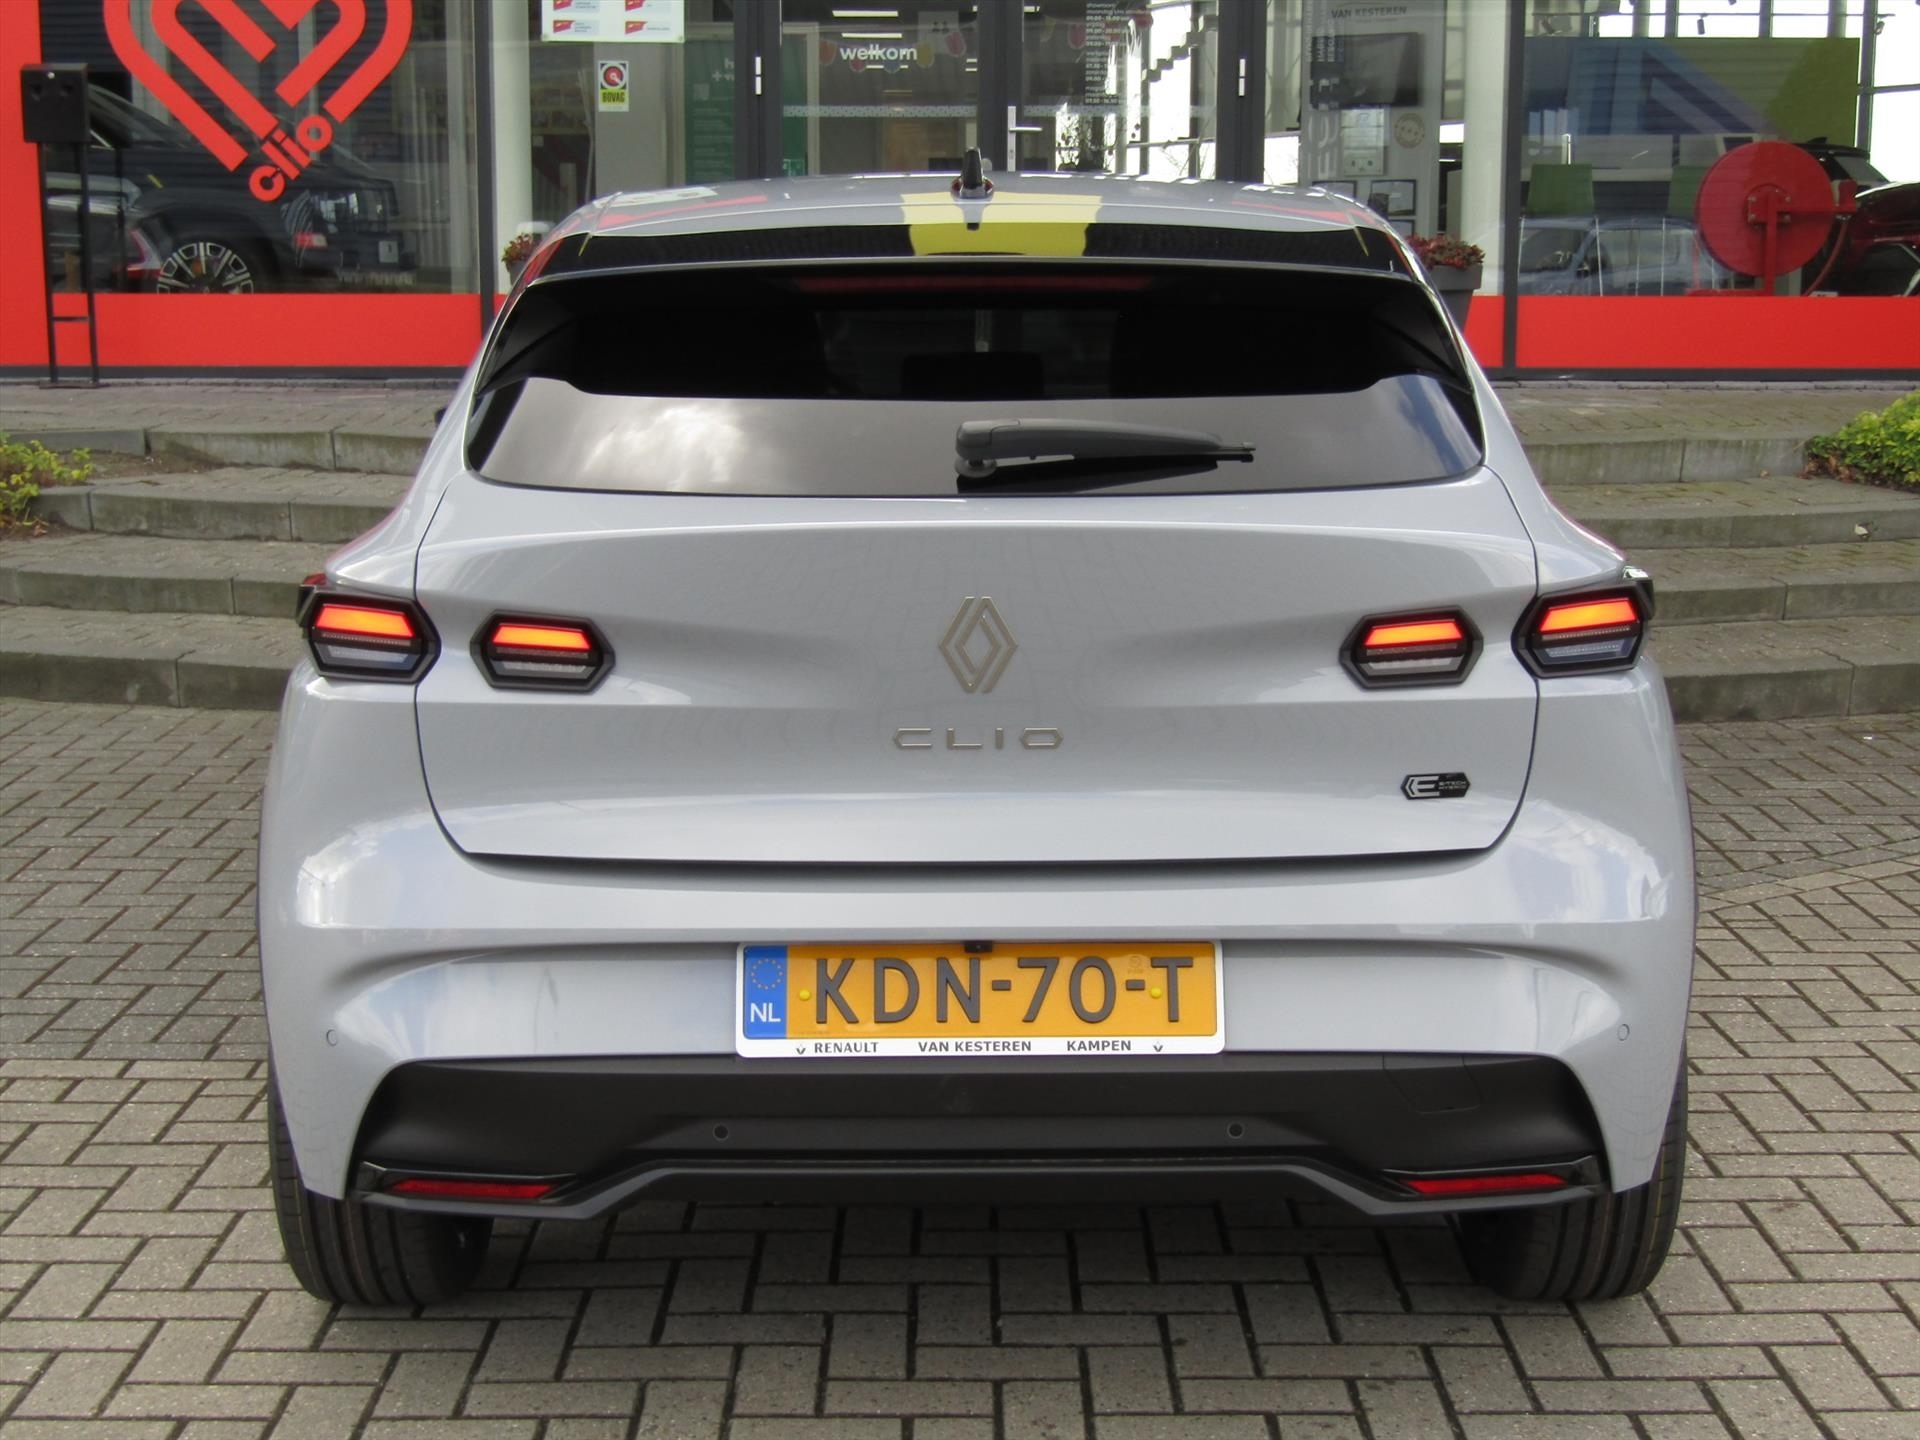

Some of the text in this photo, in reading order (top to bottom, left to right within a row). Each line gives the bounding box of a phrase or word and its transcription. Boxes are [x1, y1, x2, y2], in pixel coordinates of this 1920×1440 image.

[1331, 6, 1407, 18] VAN KESTEREN
[840, 44, 917, 61] welkom
[602, 92, 625, 103] BOVAG
[249, 114, 333, 202] clio
[893, 727, 1065, 751] CLIO
[816, 956, 1194, 1025] KDN-70-T
[751, 1002, 780, 1023] NL
[814, 1040, 1131, 1054] RENAULT VAN KESTEREN KAMPEN
